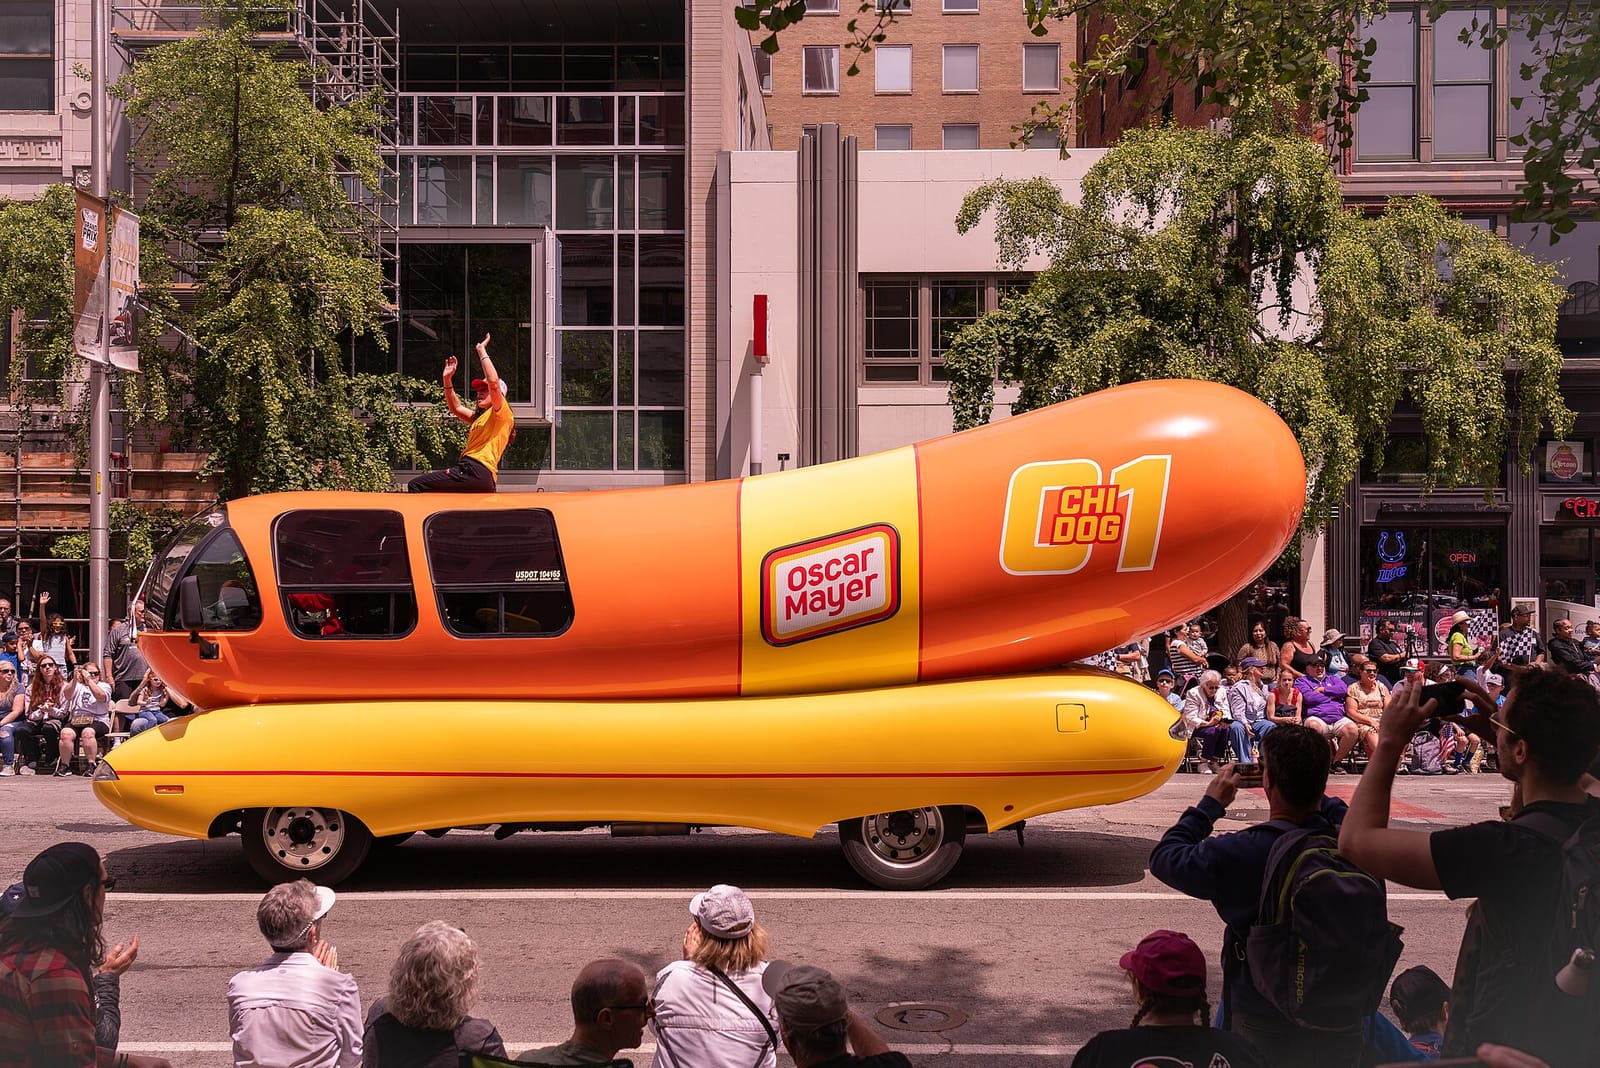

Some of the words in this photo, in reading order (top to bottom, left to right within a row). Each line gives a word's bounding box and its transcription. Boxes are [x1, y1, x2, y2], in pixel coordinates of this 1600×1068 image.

[83, 228, 98, 242] PRIX
[1060, 487, 1117, 515] CHI
[1564, 496, 1600, 517] CR
[1053, 515, 1121, 543] DOG
[788, 548, 874, 591] Oscar
[1449, 553, 1476, 563] OPEN
[515, 570, 538, 578] USDOT
[539, 570, 560, 578] 104165
[785, 573, 878, 620] Mayer
